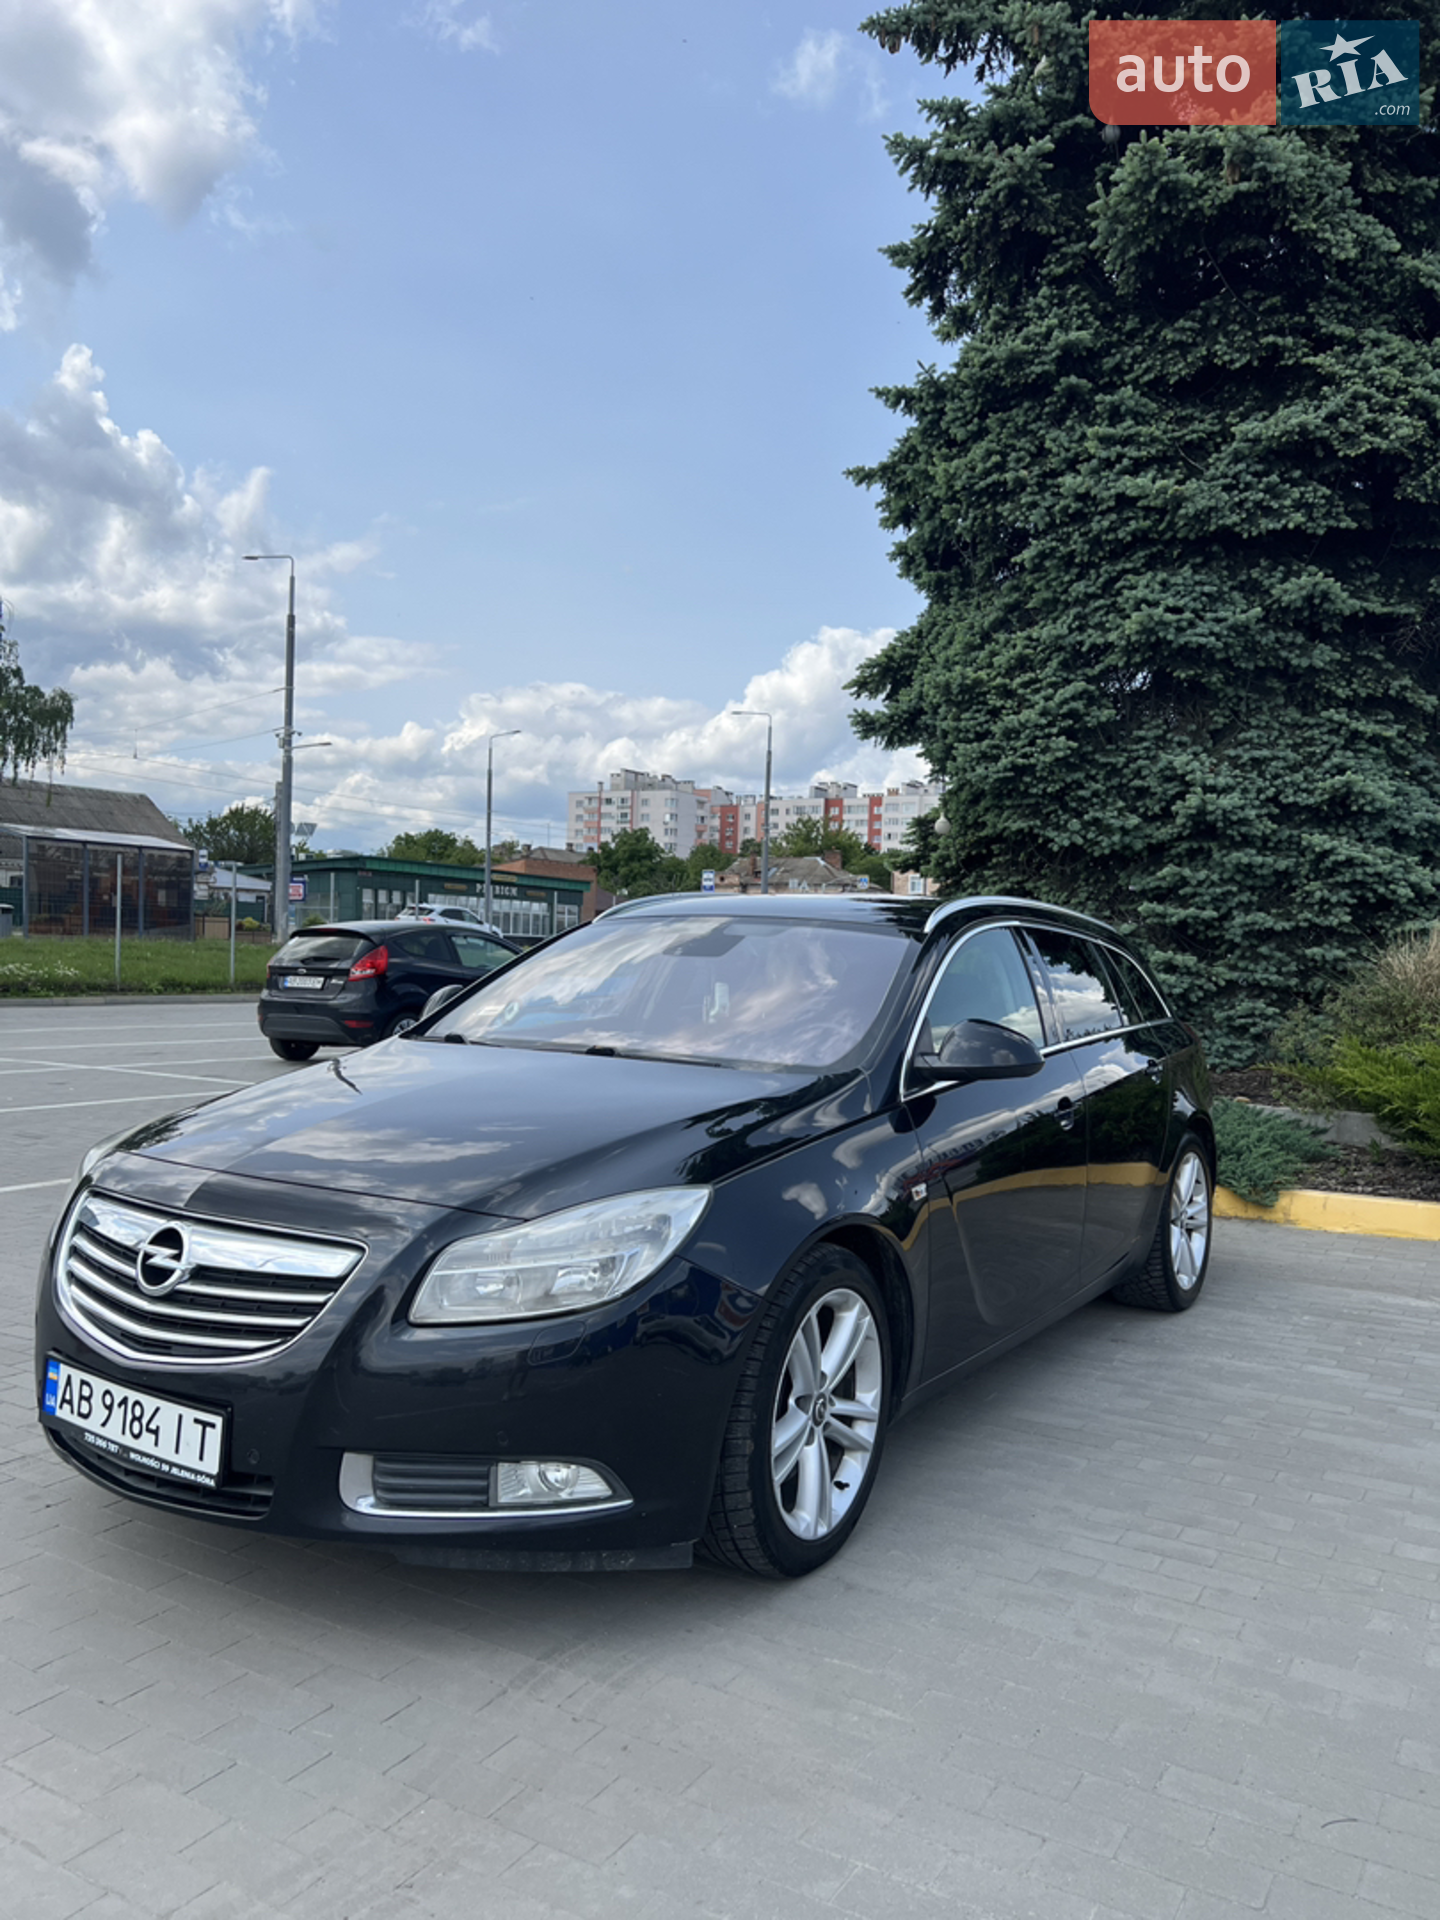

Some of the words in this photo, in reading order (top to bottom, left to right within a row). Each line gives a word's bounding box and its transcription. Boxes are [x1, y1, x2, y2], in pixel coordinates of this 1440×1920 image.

[59, 1374, 94, 1421] AB
[100, 1389, 161, 1448] 9184
[175, 1413, 216, 1462] IT
